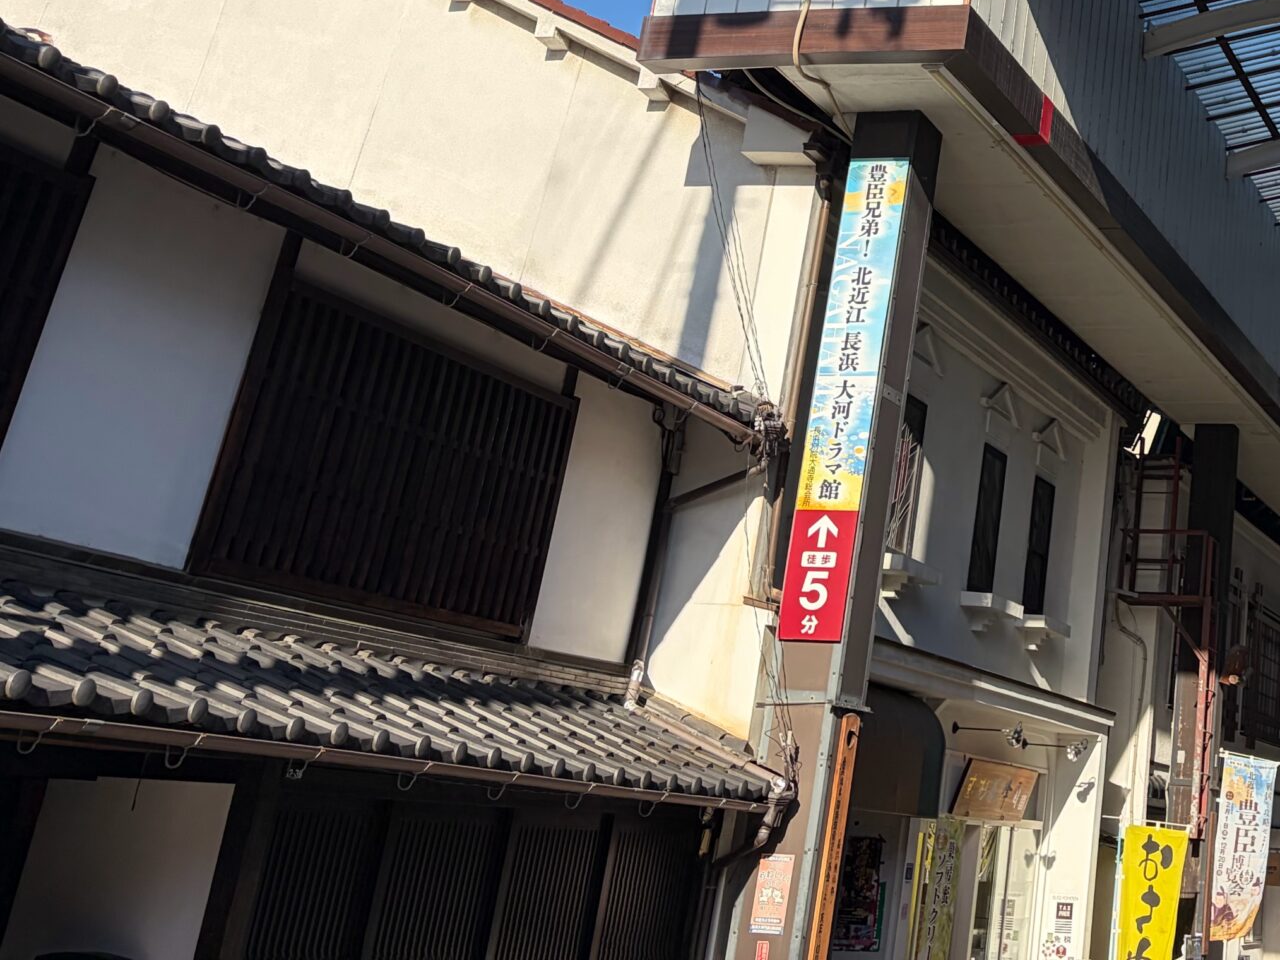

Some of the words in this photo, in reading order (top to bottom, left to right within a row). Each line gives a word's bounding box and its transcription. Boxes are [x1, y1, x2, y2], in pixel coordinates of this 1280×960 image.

[858, 163, 889, 258] 豊臣兄弟！
[846, 266, 872, 325] 北近江
[838, 332, 863, 372] 長浜
[818, 379, 855, 500] 大河ドラマ館
[807, 554, 831, 565] 徒歩
